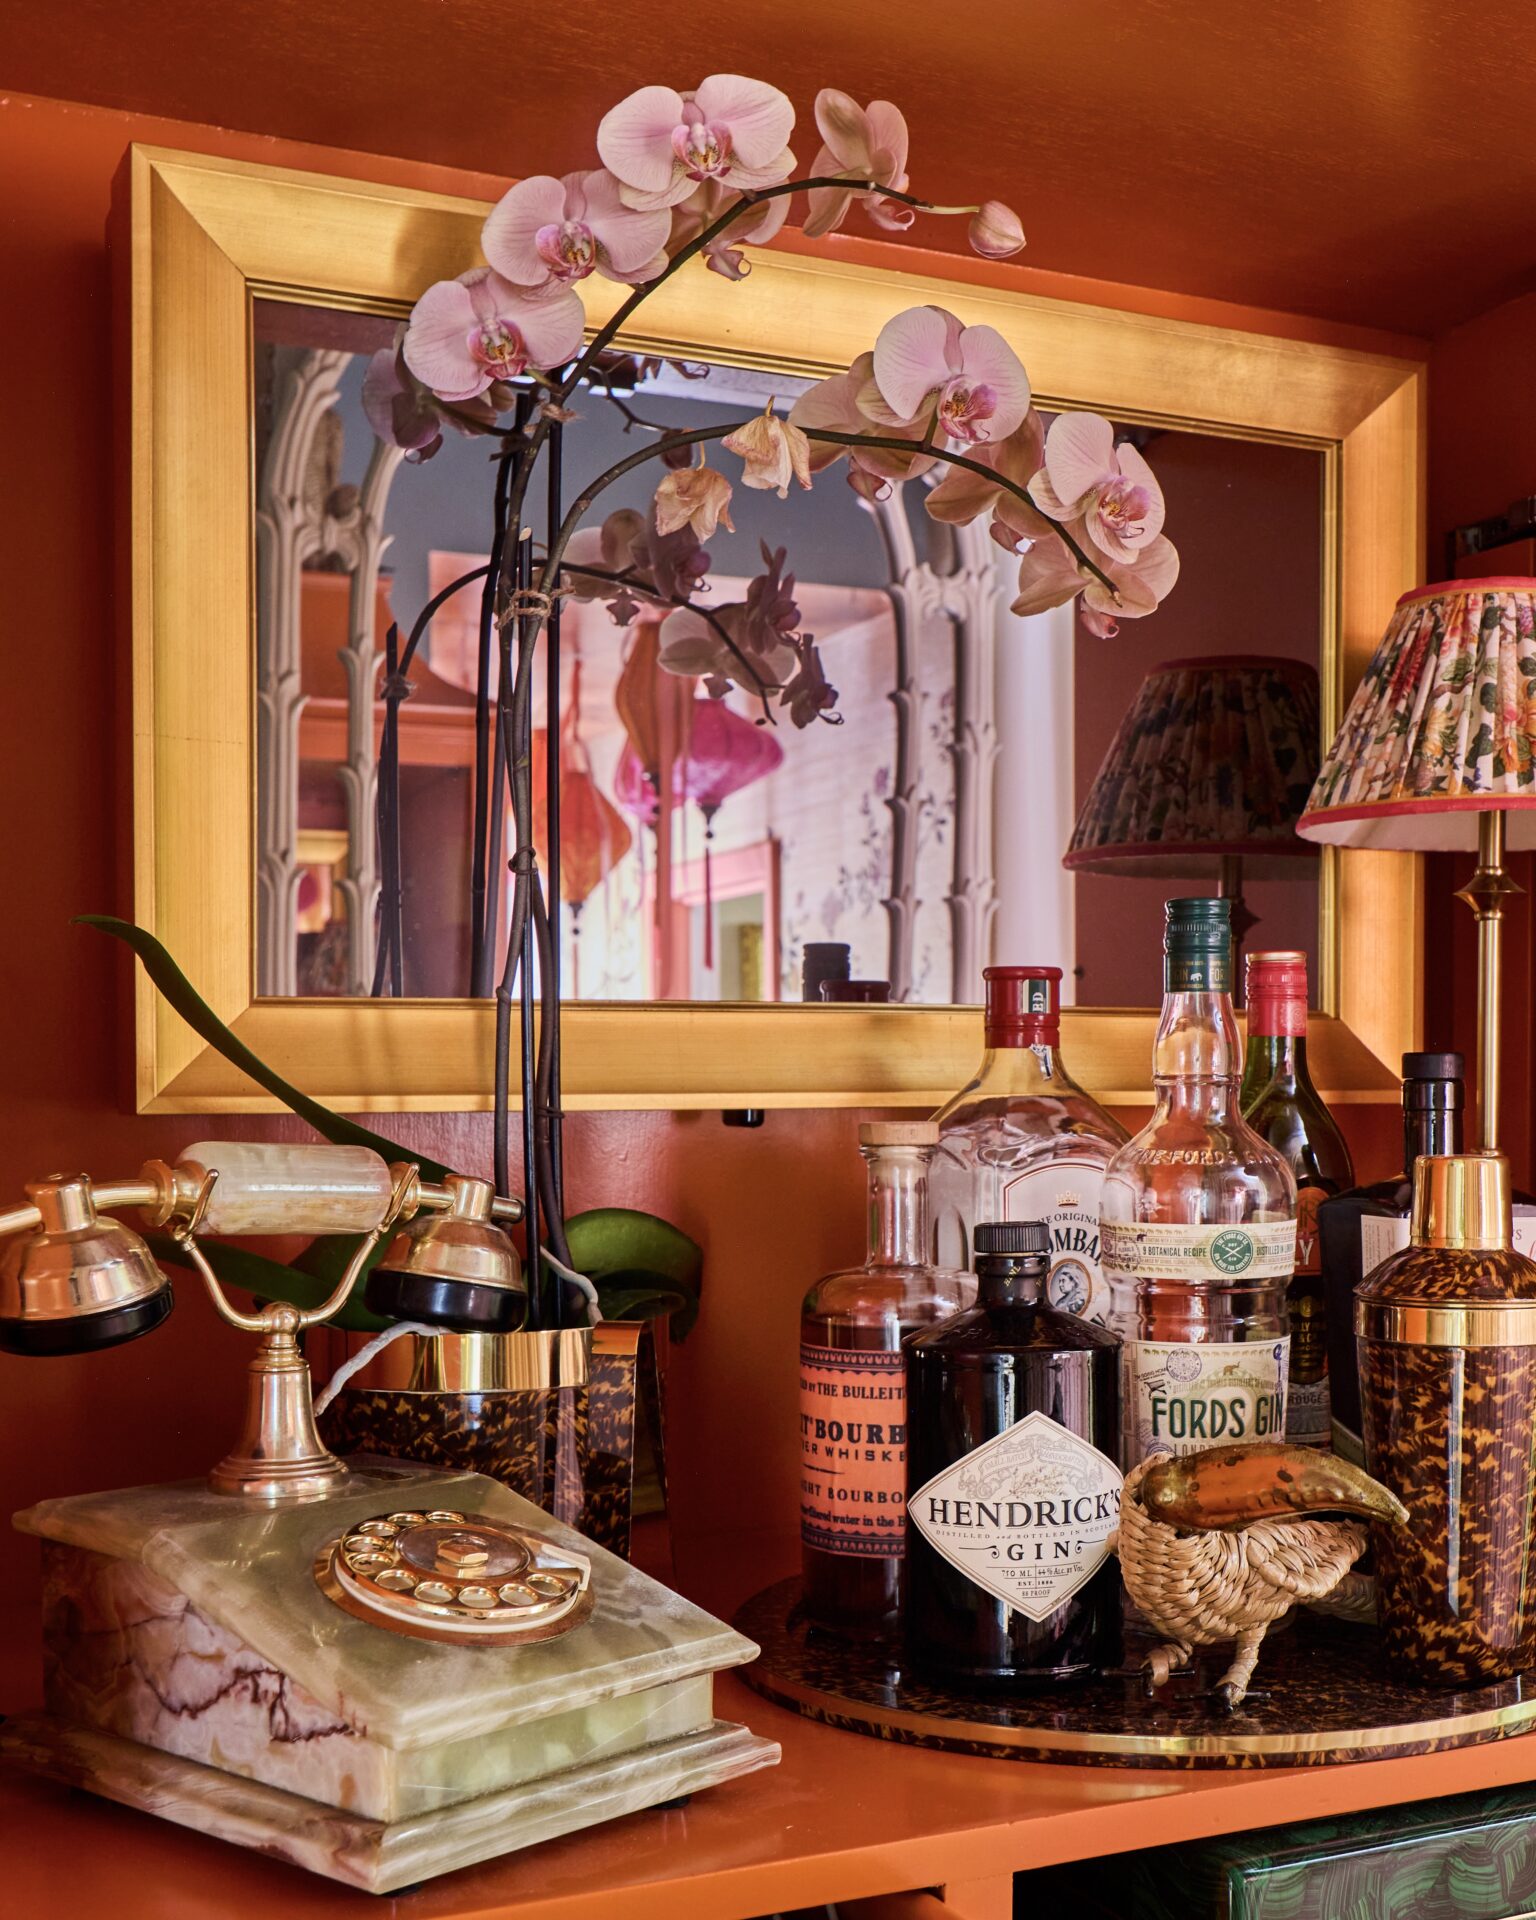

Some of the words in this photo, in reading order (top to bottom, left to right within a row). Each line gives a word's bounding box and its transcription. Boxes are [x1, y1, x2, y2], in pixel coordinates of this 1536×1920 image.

[1170, 1149, 1239, 1166] FORDS
[1049, 1227, 1101, 1267] MBA
[1148, 1246, 1182, 1257] BOTANICAL
[1184, 1247, 1208, 1257] RECIPE
[817, 1381, 838, 1398] THE
[1152, 1397, 1246, 1439] FORDS
[1255, 1393, 1284, 1436] GIN
[928, 1488, 1121, 1529] HENDRICK'S
[833, 1513, 860, 1525] water
[863, 1514, 873, 1526] in
[876, 1515, 895, 1528] the
[936, 1529, 991, 1540] DISTILLED
[1017, 1530, 1066, 1540] BOTTLED
[1070, 1529, 1081, 1537] IN
[1006, 1540, 1071, 1561] GIN
[1030, 1589, 1051, 1597] PROOF
